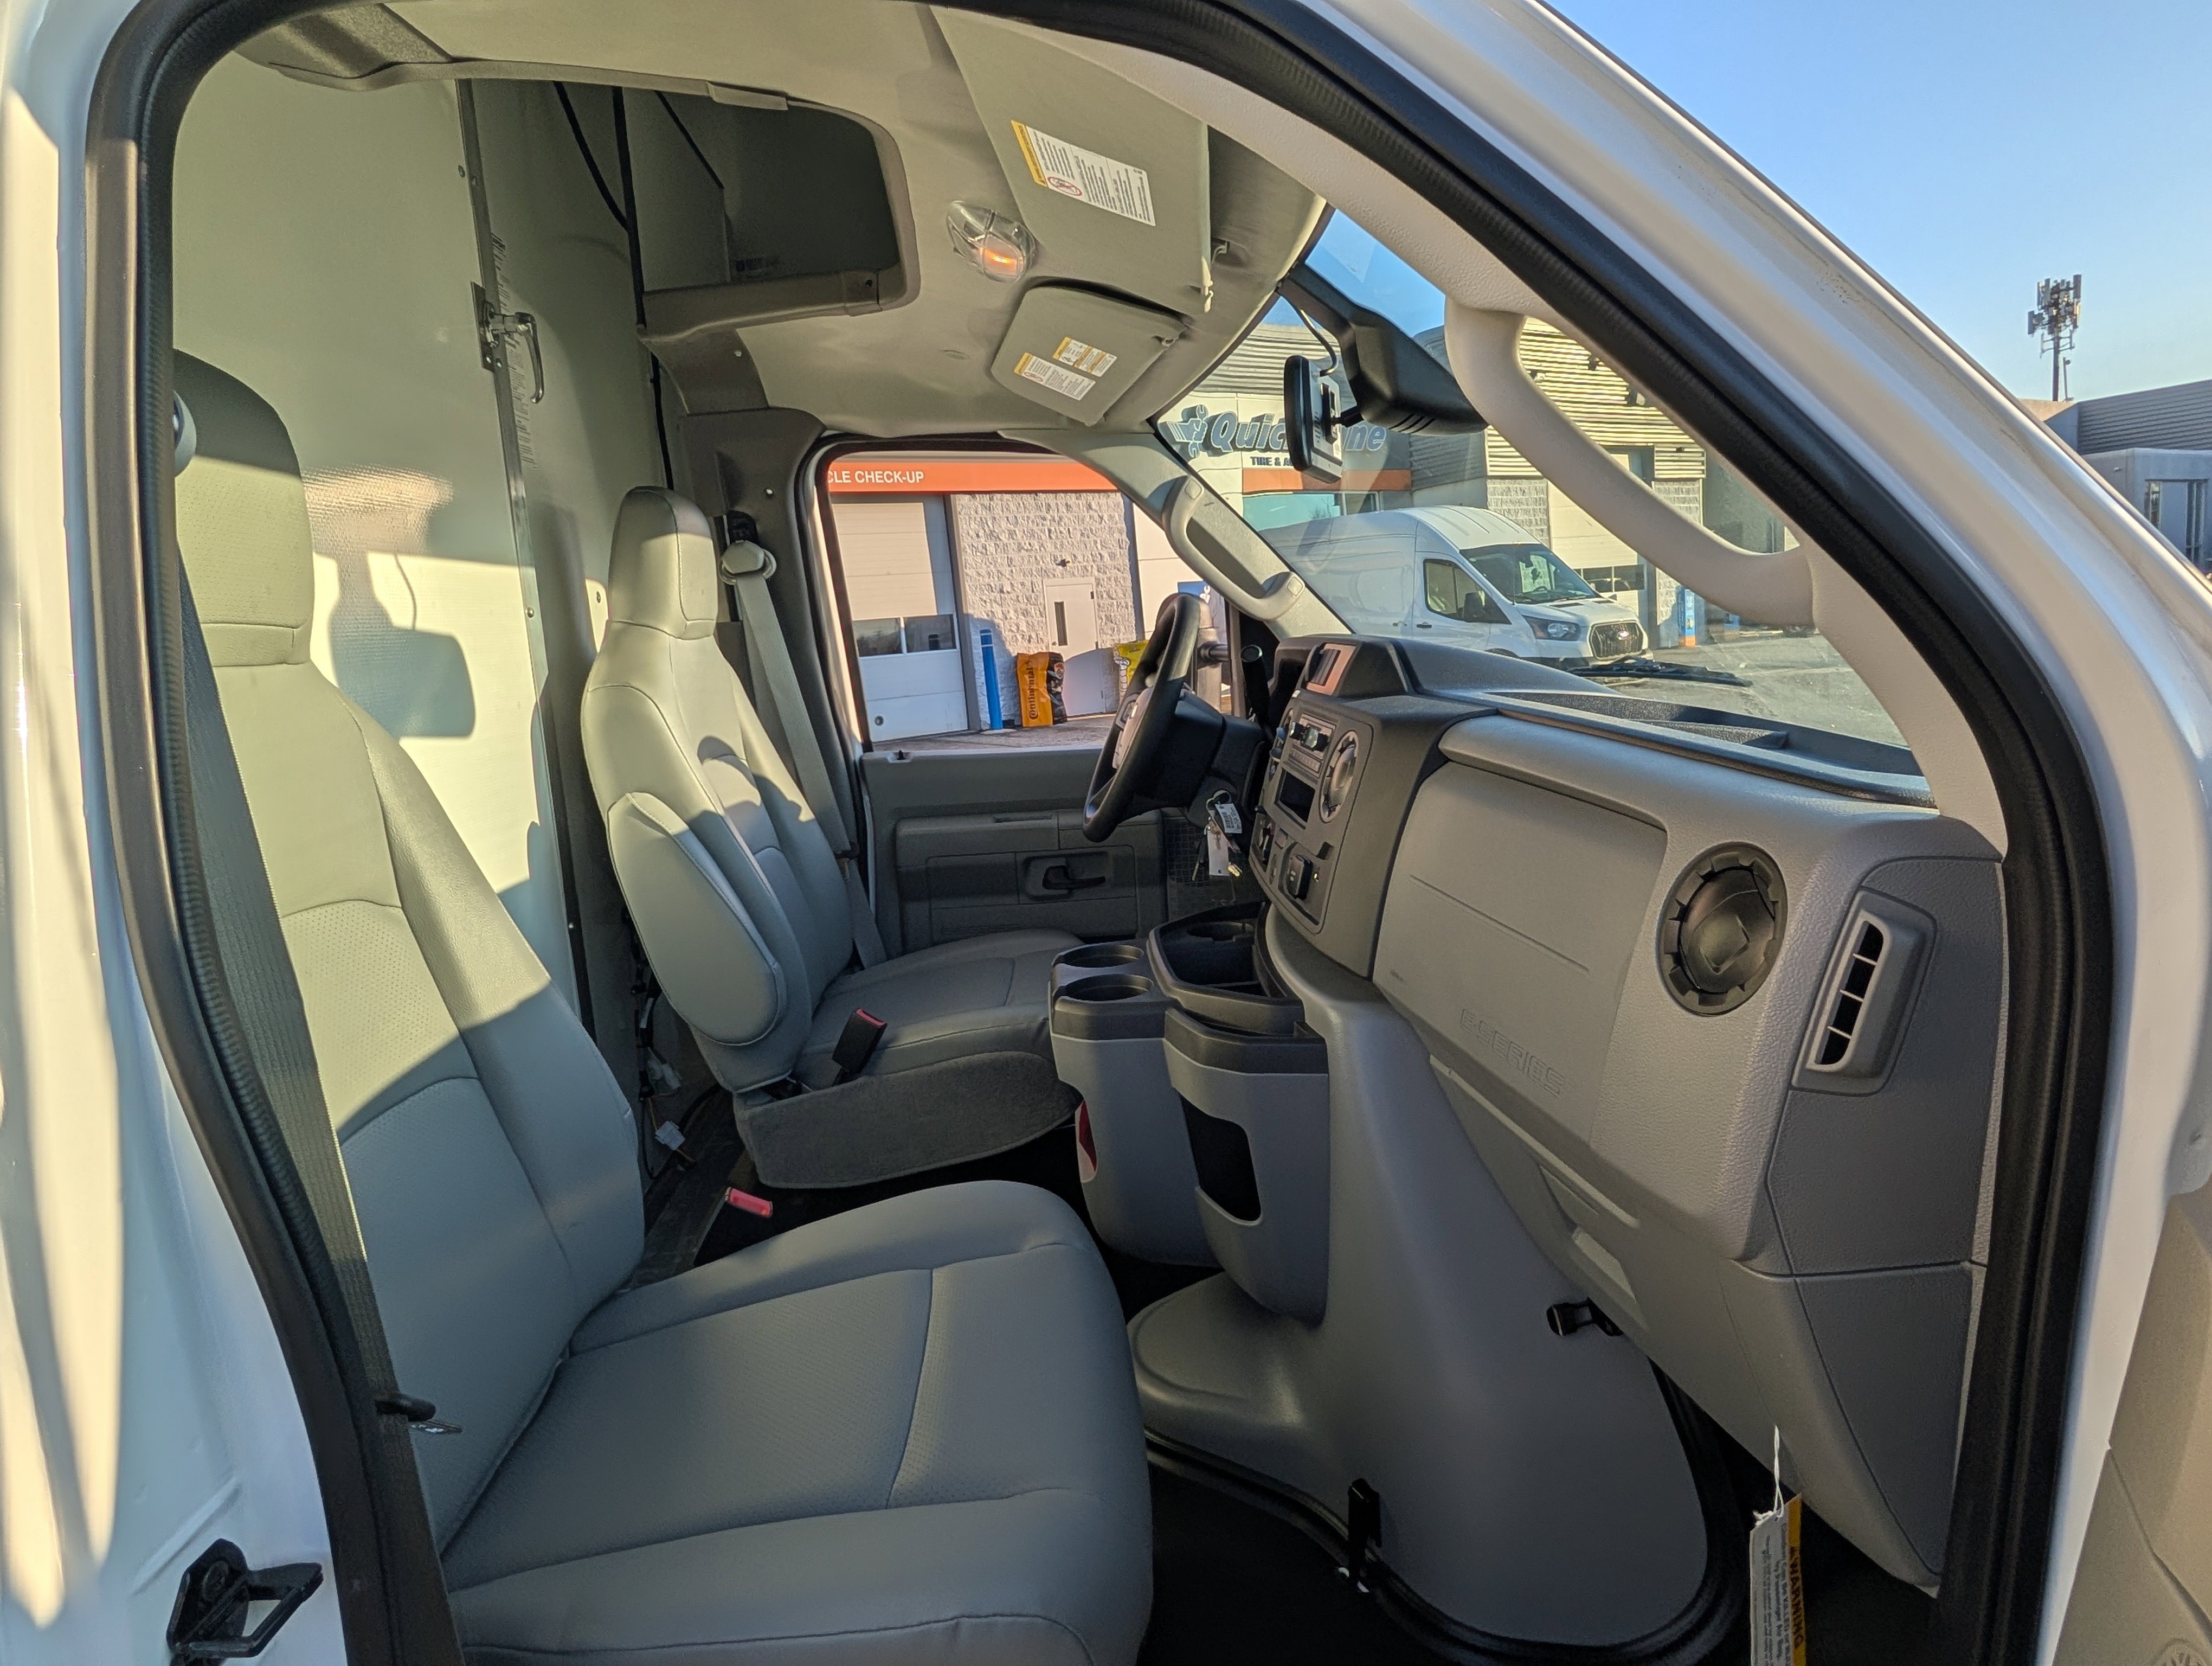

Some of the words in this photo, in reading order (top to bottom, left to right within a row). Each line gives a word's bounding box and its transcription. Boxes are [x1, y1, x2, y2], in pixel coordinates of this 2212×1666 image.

[1250, 456, 1273, 466] TIRE
[1274, 457, 1281, 466] &
[827, 471, 852, 483] CLE
[854, 470, 924, 484] CHECK-UP
